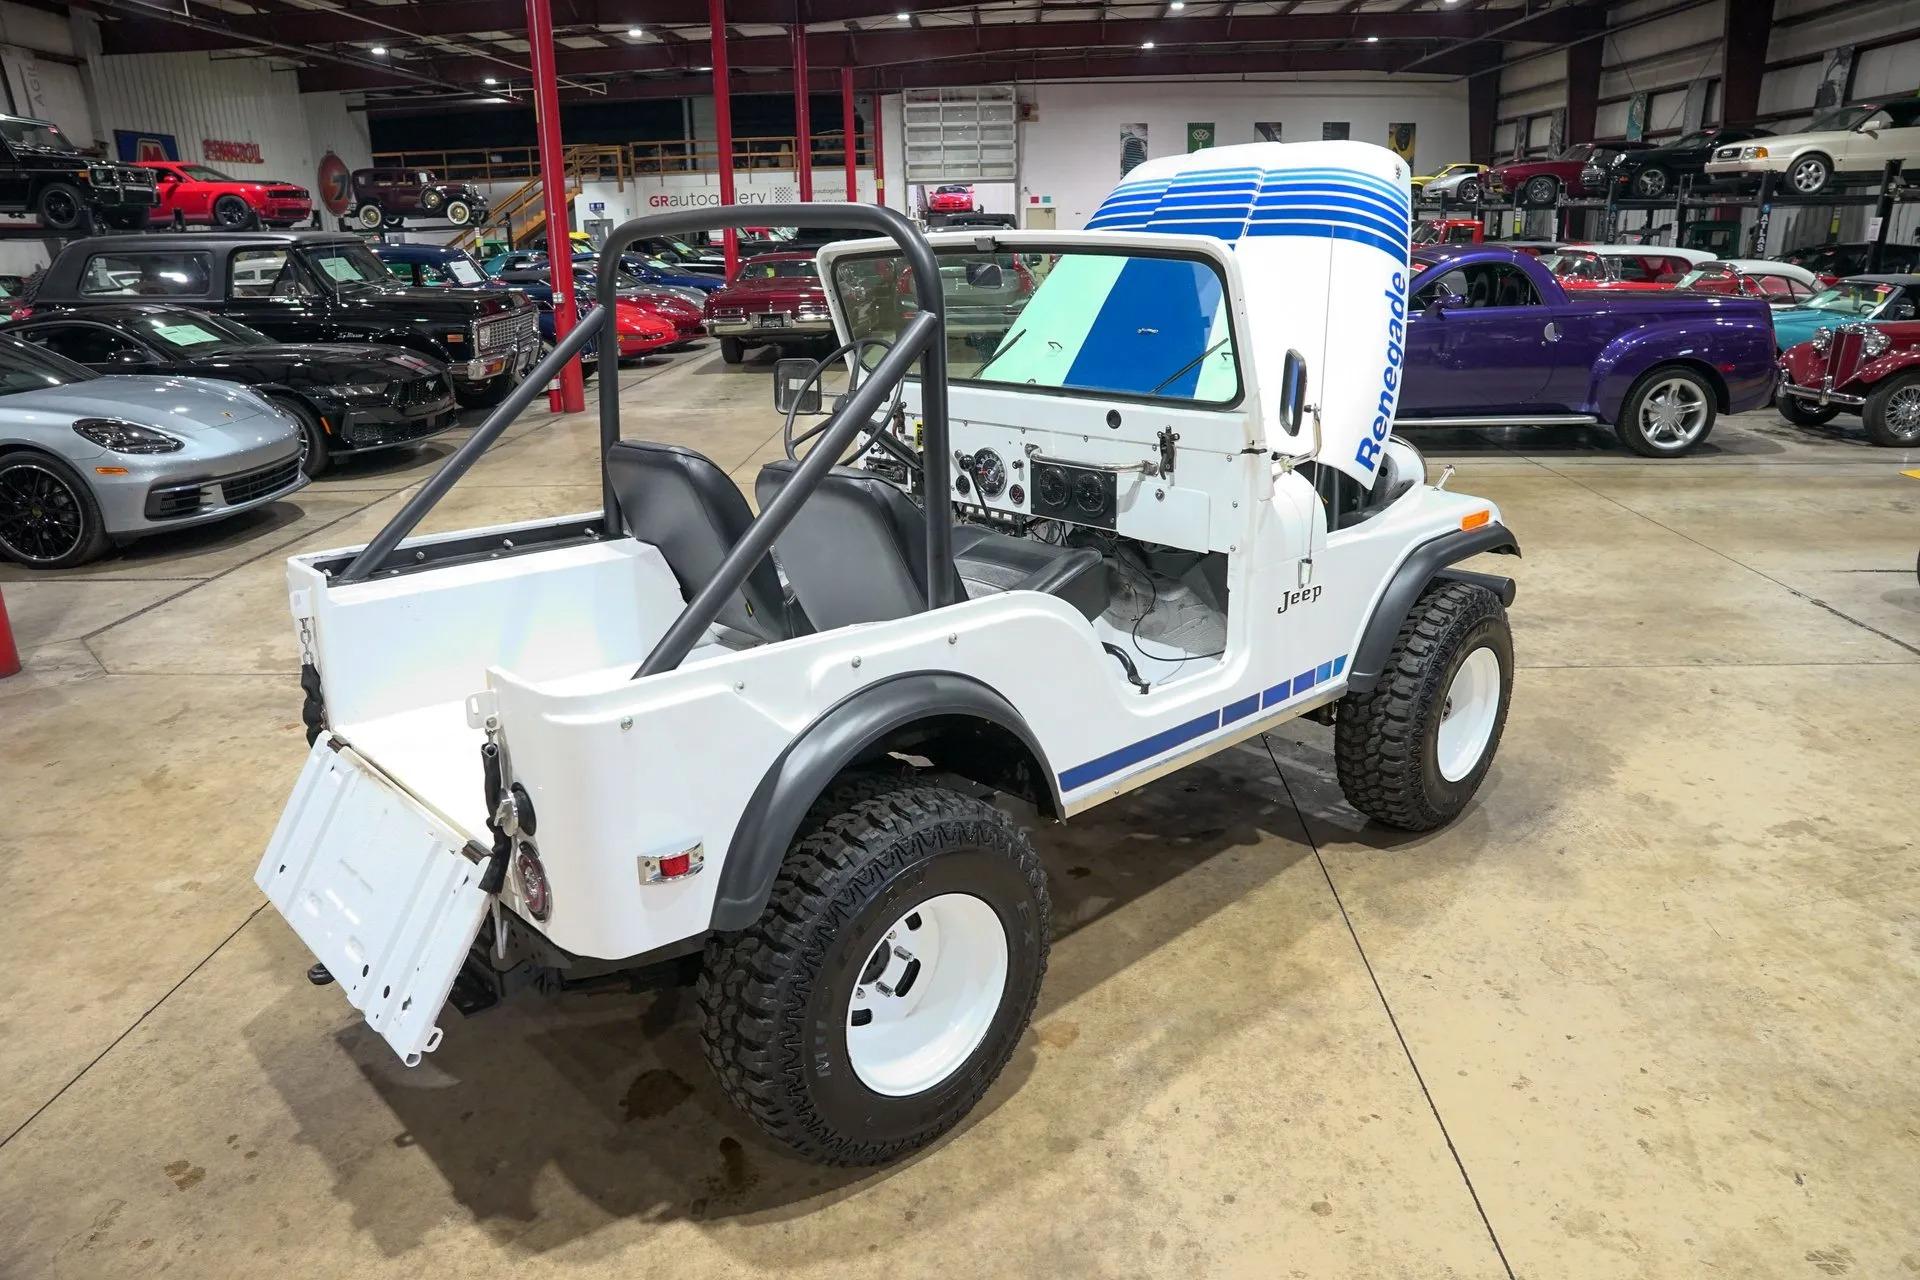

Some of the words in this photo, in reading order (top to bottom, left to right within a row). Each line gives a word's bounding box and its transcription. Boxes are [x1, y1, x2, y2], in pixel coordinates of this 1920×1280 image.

[1756, 213, 1769, 252] ATLAS
[1355, 271, 1406, 473] Renegade
[1277, 585, 1322, 614] Jeep
